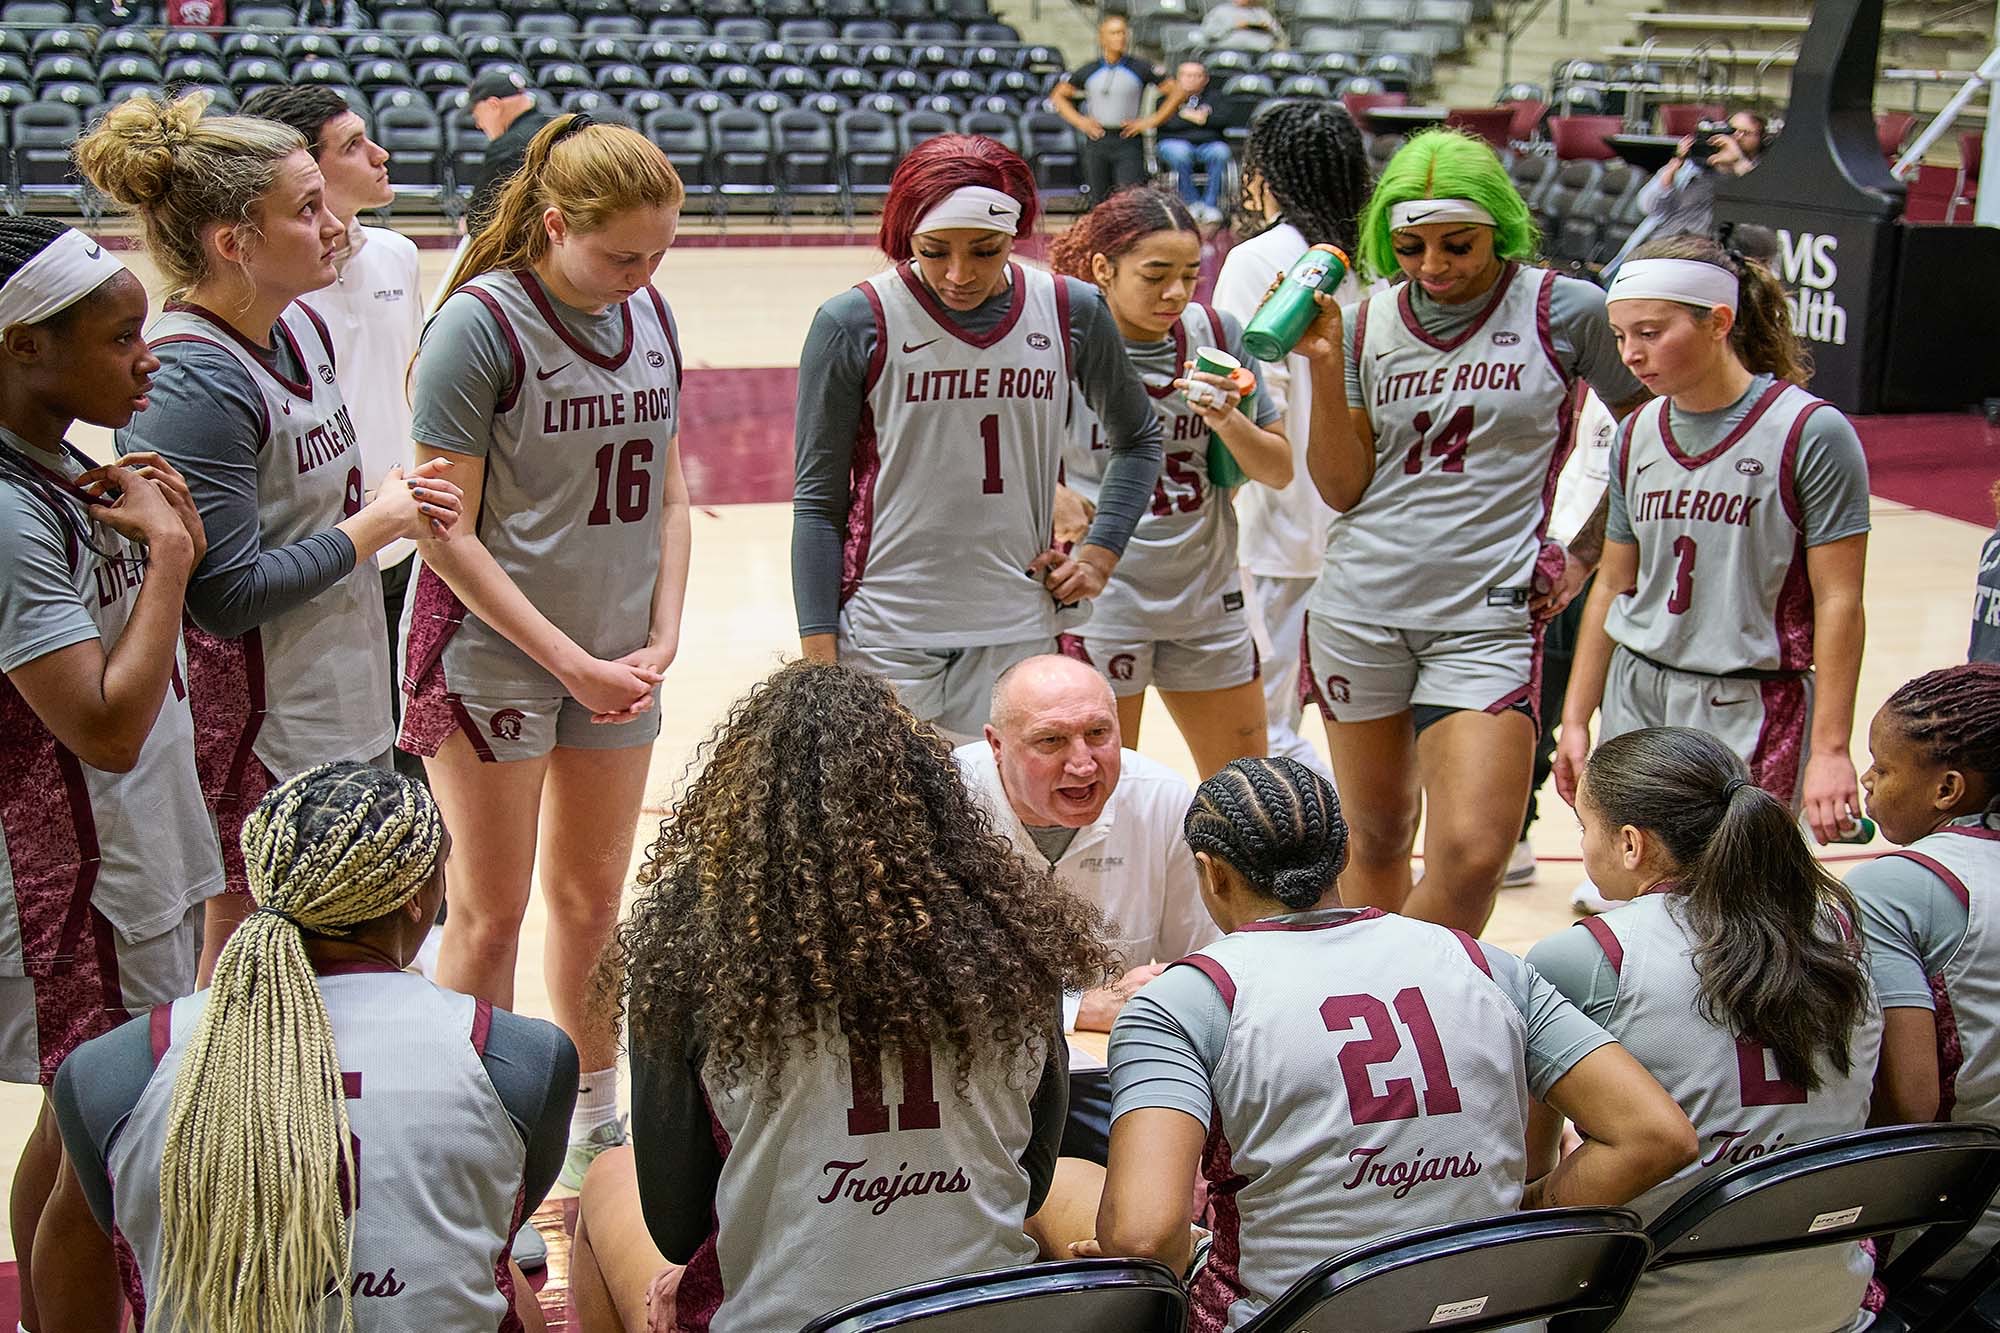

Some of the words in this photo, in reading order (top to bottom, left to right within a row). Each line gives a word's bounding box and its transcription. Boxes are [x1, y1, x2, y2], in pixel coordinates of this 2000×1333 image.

[1776, 228, 1838, 290] MS
[1783, 285, 1848, 346] alth
[543, 392, 625, 434] LITTLE
[906, 369, 990, 403] LITTLE
[998, 367, 1056, 401] ROCK
[1376, 367, 1449, 407] LITTLE
[1452, 361, 1526, 392] ROCK
[295, 418, 346, 475] LITTLE
[333, 403, 357, 448] RO
[980, 414, 1004, 494] 1
[1403, 405, 1475, 475] 14
[587, 438, 655, 526] 16
[1151, 450, 1202, 516] 15
[1689, 490, 1762, 528] ROCK
[1667, 535, 1697, 615] 3
[840, 1010, 942, 1137] 11
[1318, 986, 1463, 1126] 21
[817, 1158, 971, 1216] Trojans
[1342, 1144, 1482, 1200] Trojans
